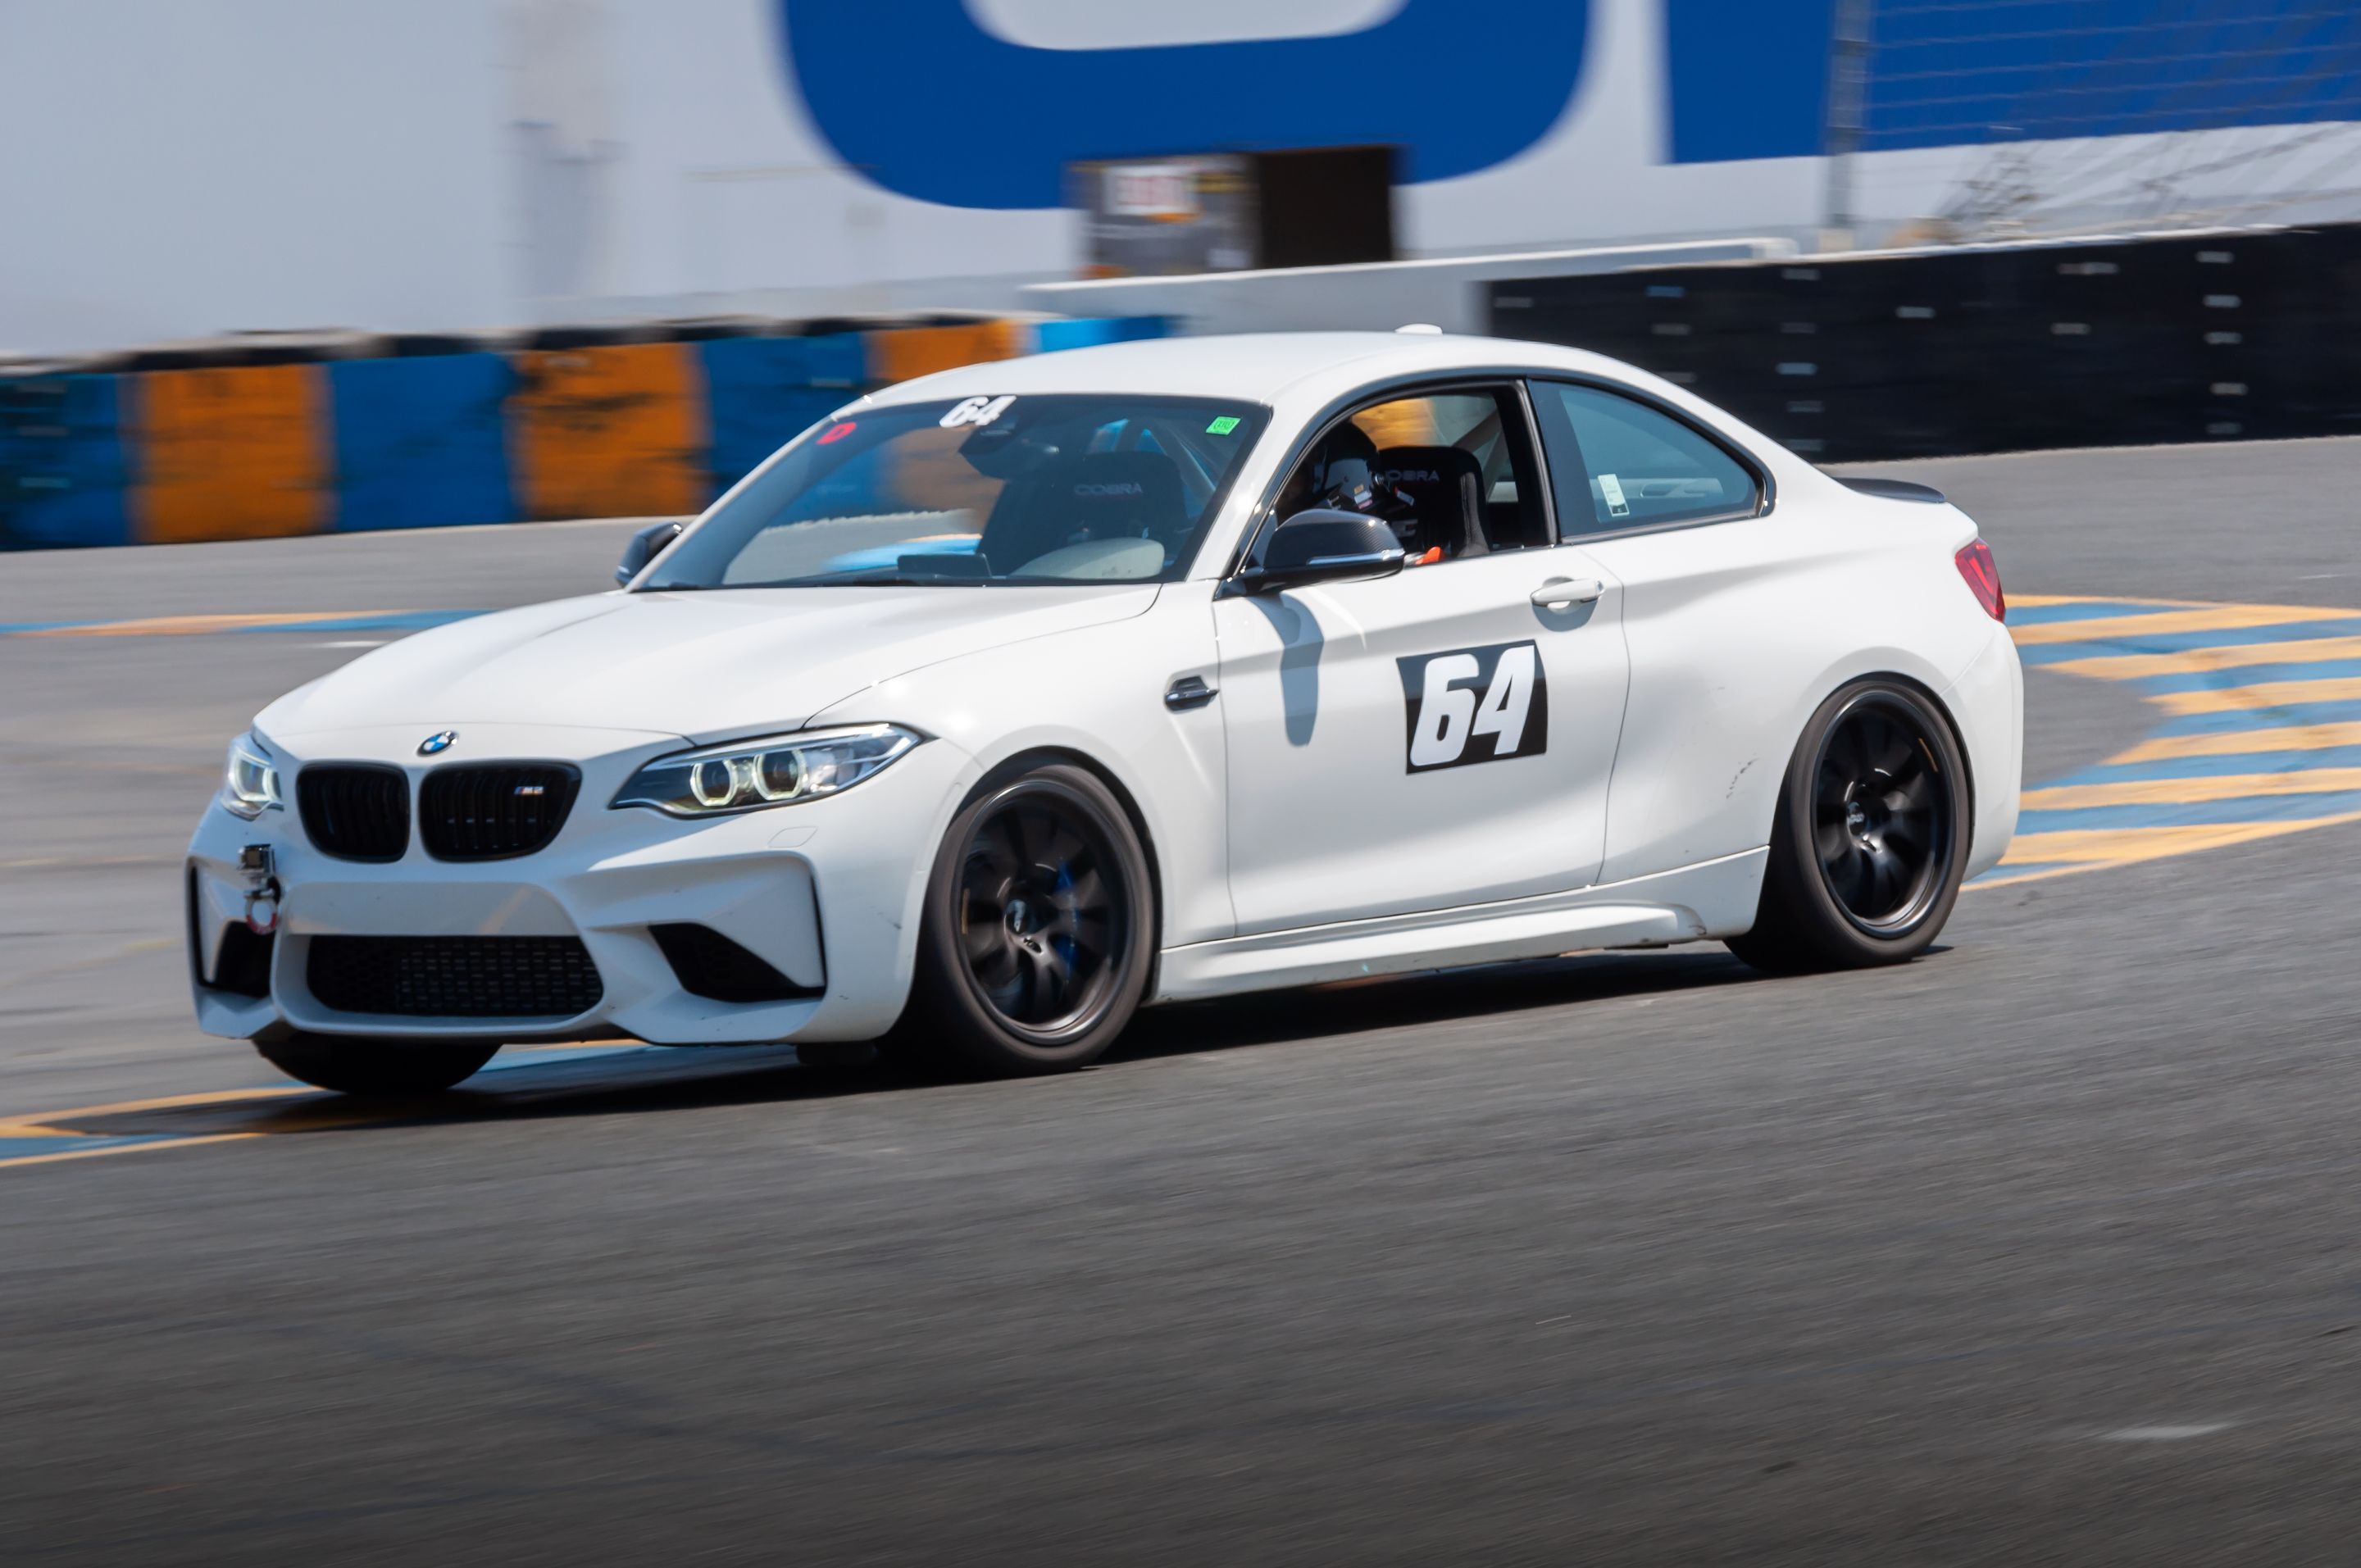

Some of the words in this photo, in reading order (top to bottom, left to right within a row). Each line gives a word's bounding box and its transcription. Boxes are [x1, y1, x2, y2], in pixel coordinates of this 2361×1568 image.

[939, 395, 1017, 428] 64
[1384, 469, 1440, 483] OBRA
[1073, 482, 1144, 496] COBRA
[1409, 644, 1535, 767] 64
